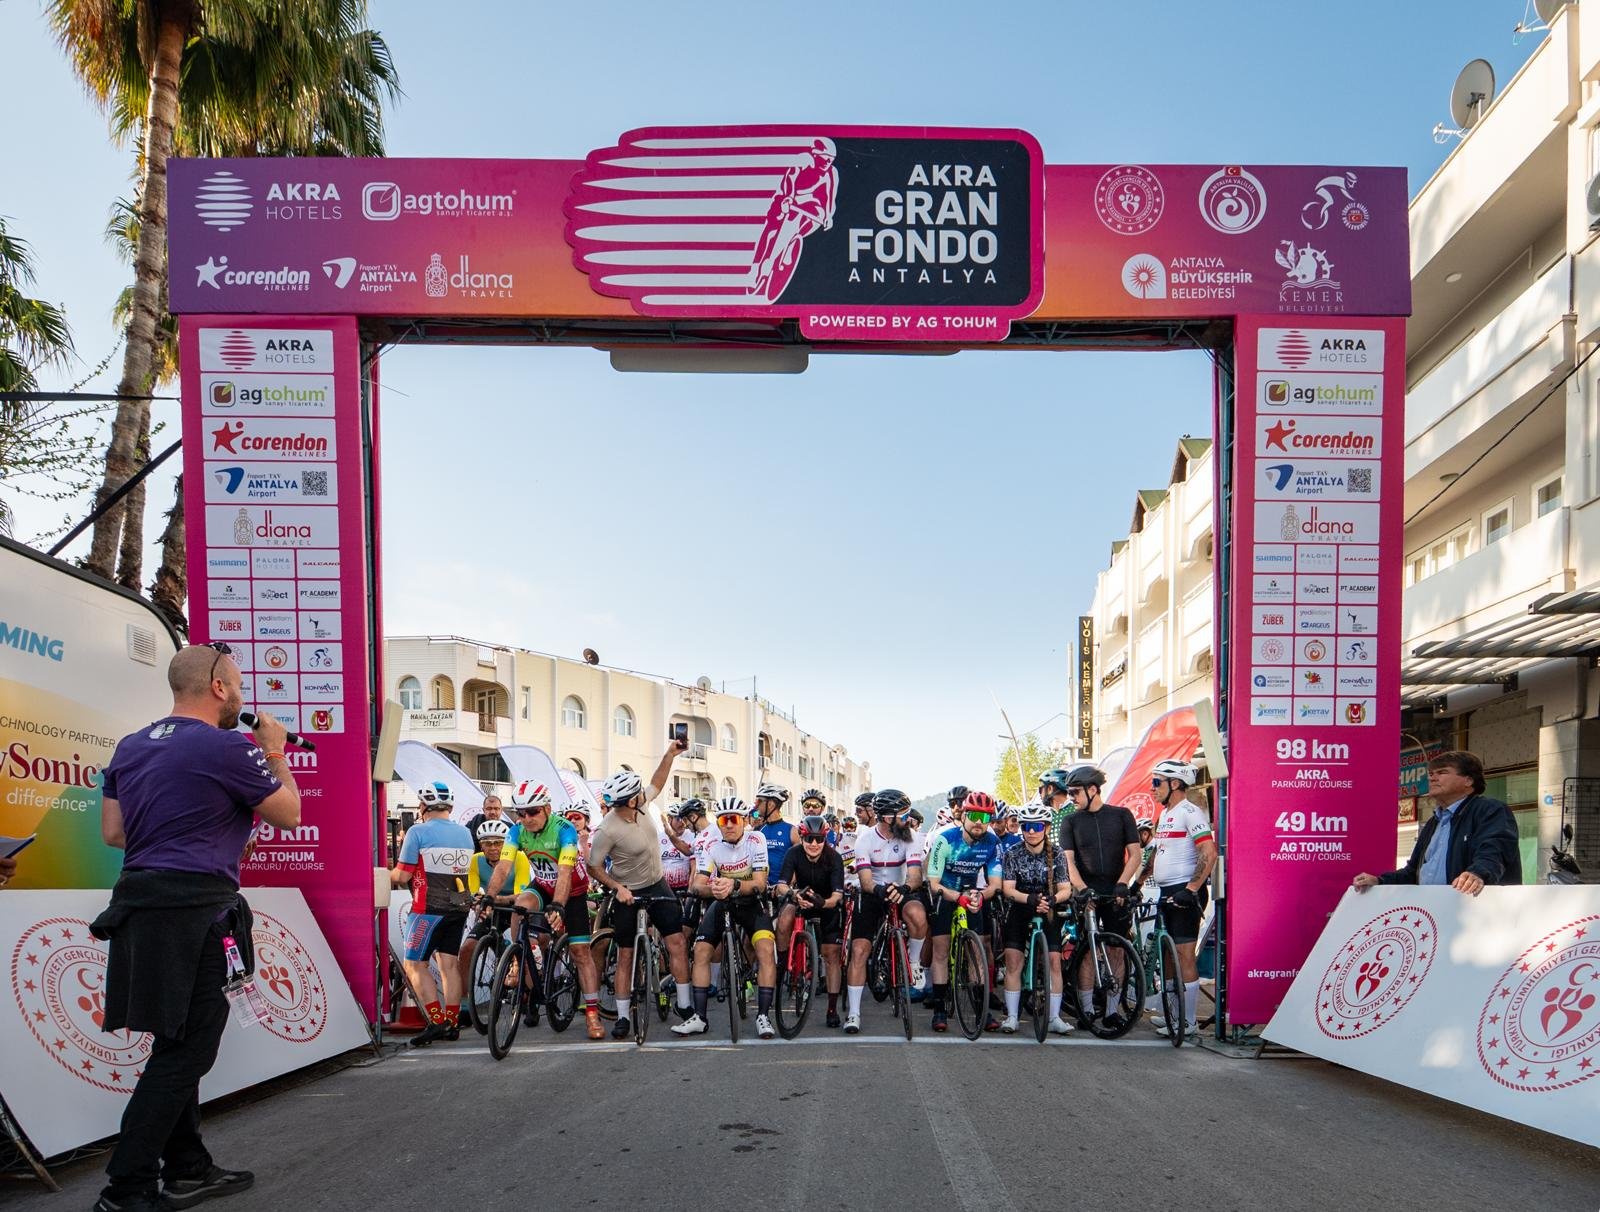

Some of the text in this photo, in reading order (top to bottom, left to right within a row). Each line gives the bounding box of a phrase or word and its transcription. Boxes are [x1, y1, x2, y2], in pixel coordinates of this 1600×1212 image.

[907, 164, 997, 187] AKRA
[266, 183, 341, 201] AKRA
[266, 206, 342, 220] HOTELS
[436, 209, 465, 217] sanayi
[467, 209, 496, 217] ticaret
[875, 190, 998, 226] GRAN
[849, 227, 998, 264] FONDO
[1170, 256, 1224, 269] ANTALYA
[224, 265, 311, 286] corendon
[360, 271, 417, 282] ANTALYA
[450, 255, 513, 289] diana
[848, 268, 997, 284] ANTALYA
[1170, 270, 1253, 287] BÜYÜKŞEHİR
[360, 283, 393, 293] Airport
[461, 290, 513, 298] TRAVEL
[1171, 286, 1236, 300] BELEDİYESİ
[1279, 290, 1344, 303] KEMER
[810, 315, 997, 329] POWERED BY AG TOHUM
[265, 339, 314, 351] AKRA
[1320, 339, 1366, 351] AKRA
[265, 353, 315, 364] HOTELS
[1320, 353, 1367, 363] HOTELS
[241, 433, 327, 451] corendon
[1292, 431, 1373, 449] corendon
[248, 479, 299, 490] ANTALYA
[1296, 477, 1344, 487] ANTALYA
[248, 489, 277, 498] Airport
[1296, 487, 1323, 495] Airport
[256, 510, 311, 538] diana
[1301, 506, 1354, 534] diana
[1082, 619, 1091, 755] VOIS KEMER HOTEL
[69, 730, 116, 748] PARTNER
[1276, 739, 1349, 759] 98 km
[1295, 770, 1329, 780] AKRA
[1275, 812, 1348, 832] 49 km
[1280, 842, 1343, 852] AG TOHUM
[250, 852, 315, 862] AG TOHUM
[1318, 853, 1352, 861] COURSE
[240, 862, 282, 870] PARKURU
[289, 862, 325, 871] COURSE
[720, 860, 749, 872] Asperox
[64, 950, 108, 965] GENÇLİK
[1400, 954, 1412, 978] SPOR
[1512, 948, 1578, 1012] CUMHURİYETİ
[47, 954, 71, 1030] CUMHURİYETİ
[1508, 1013, 1527, 1053] TÜRKİYE
[72, 1030, 119, 1061] TÜRKİYE
